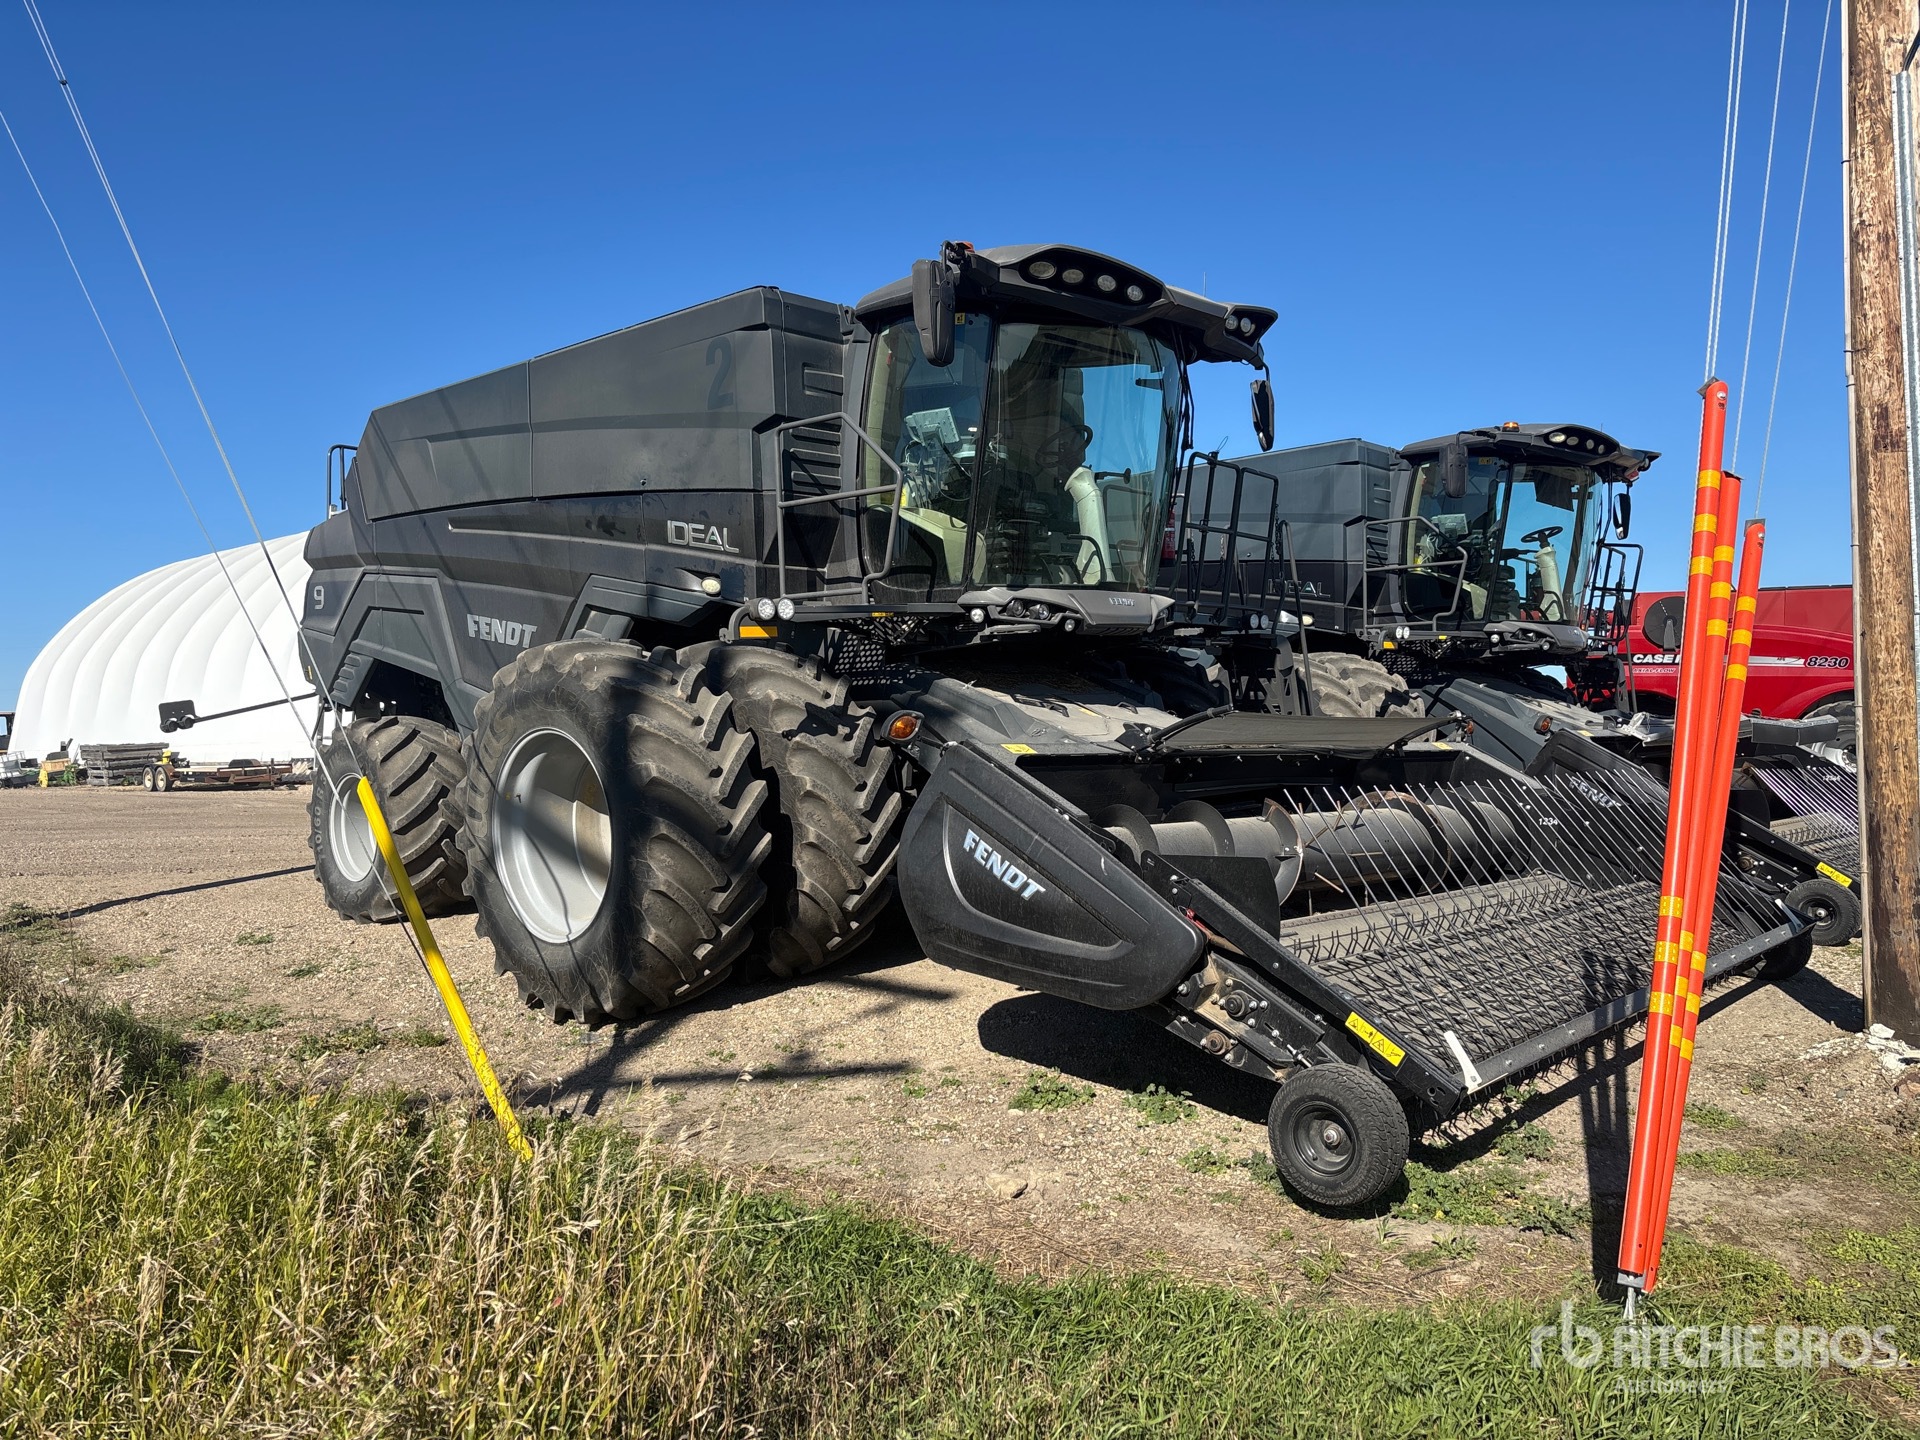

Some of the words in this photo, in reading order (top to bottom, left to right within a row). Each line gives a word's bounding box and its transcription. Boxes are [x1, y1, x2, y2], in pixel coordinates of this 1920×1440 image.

[705, 335, 734, 411] 2
[666, 519, 740, 554] IDEAL
[313, 585, 325, 610] 9
[466, 613, 538, 649] FENDT
[1632, 653, 1675, 664] CASE
[1806, 655, 1850, 669] 8230
[963, 828, 1047, 901] FENDT
